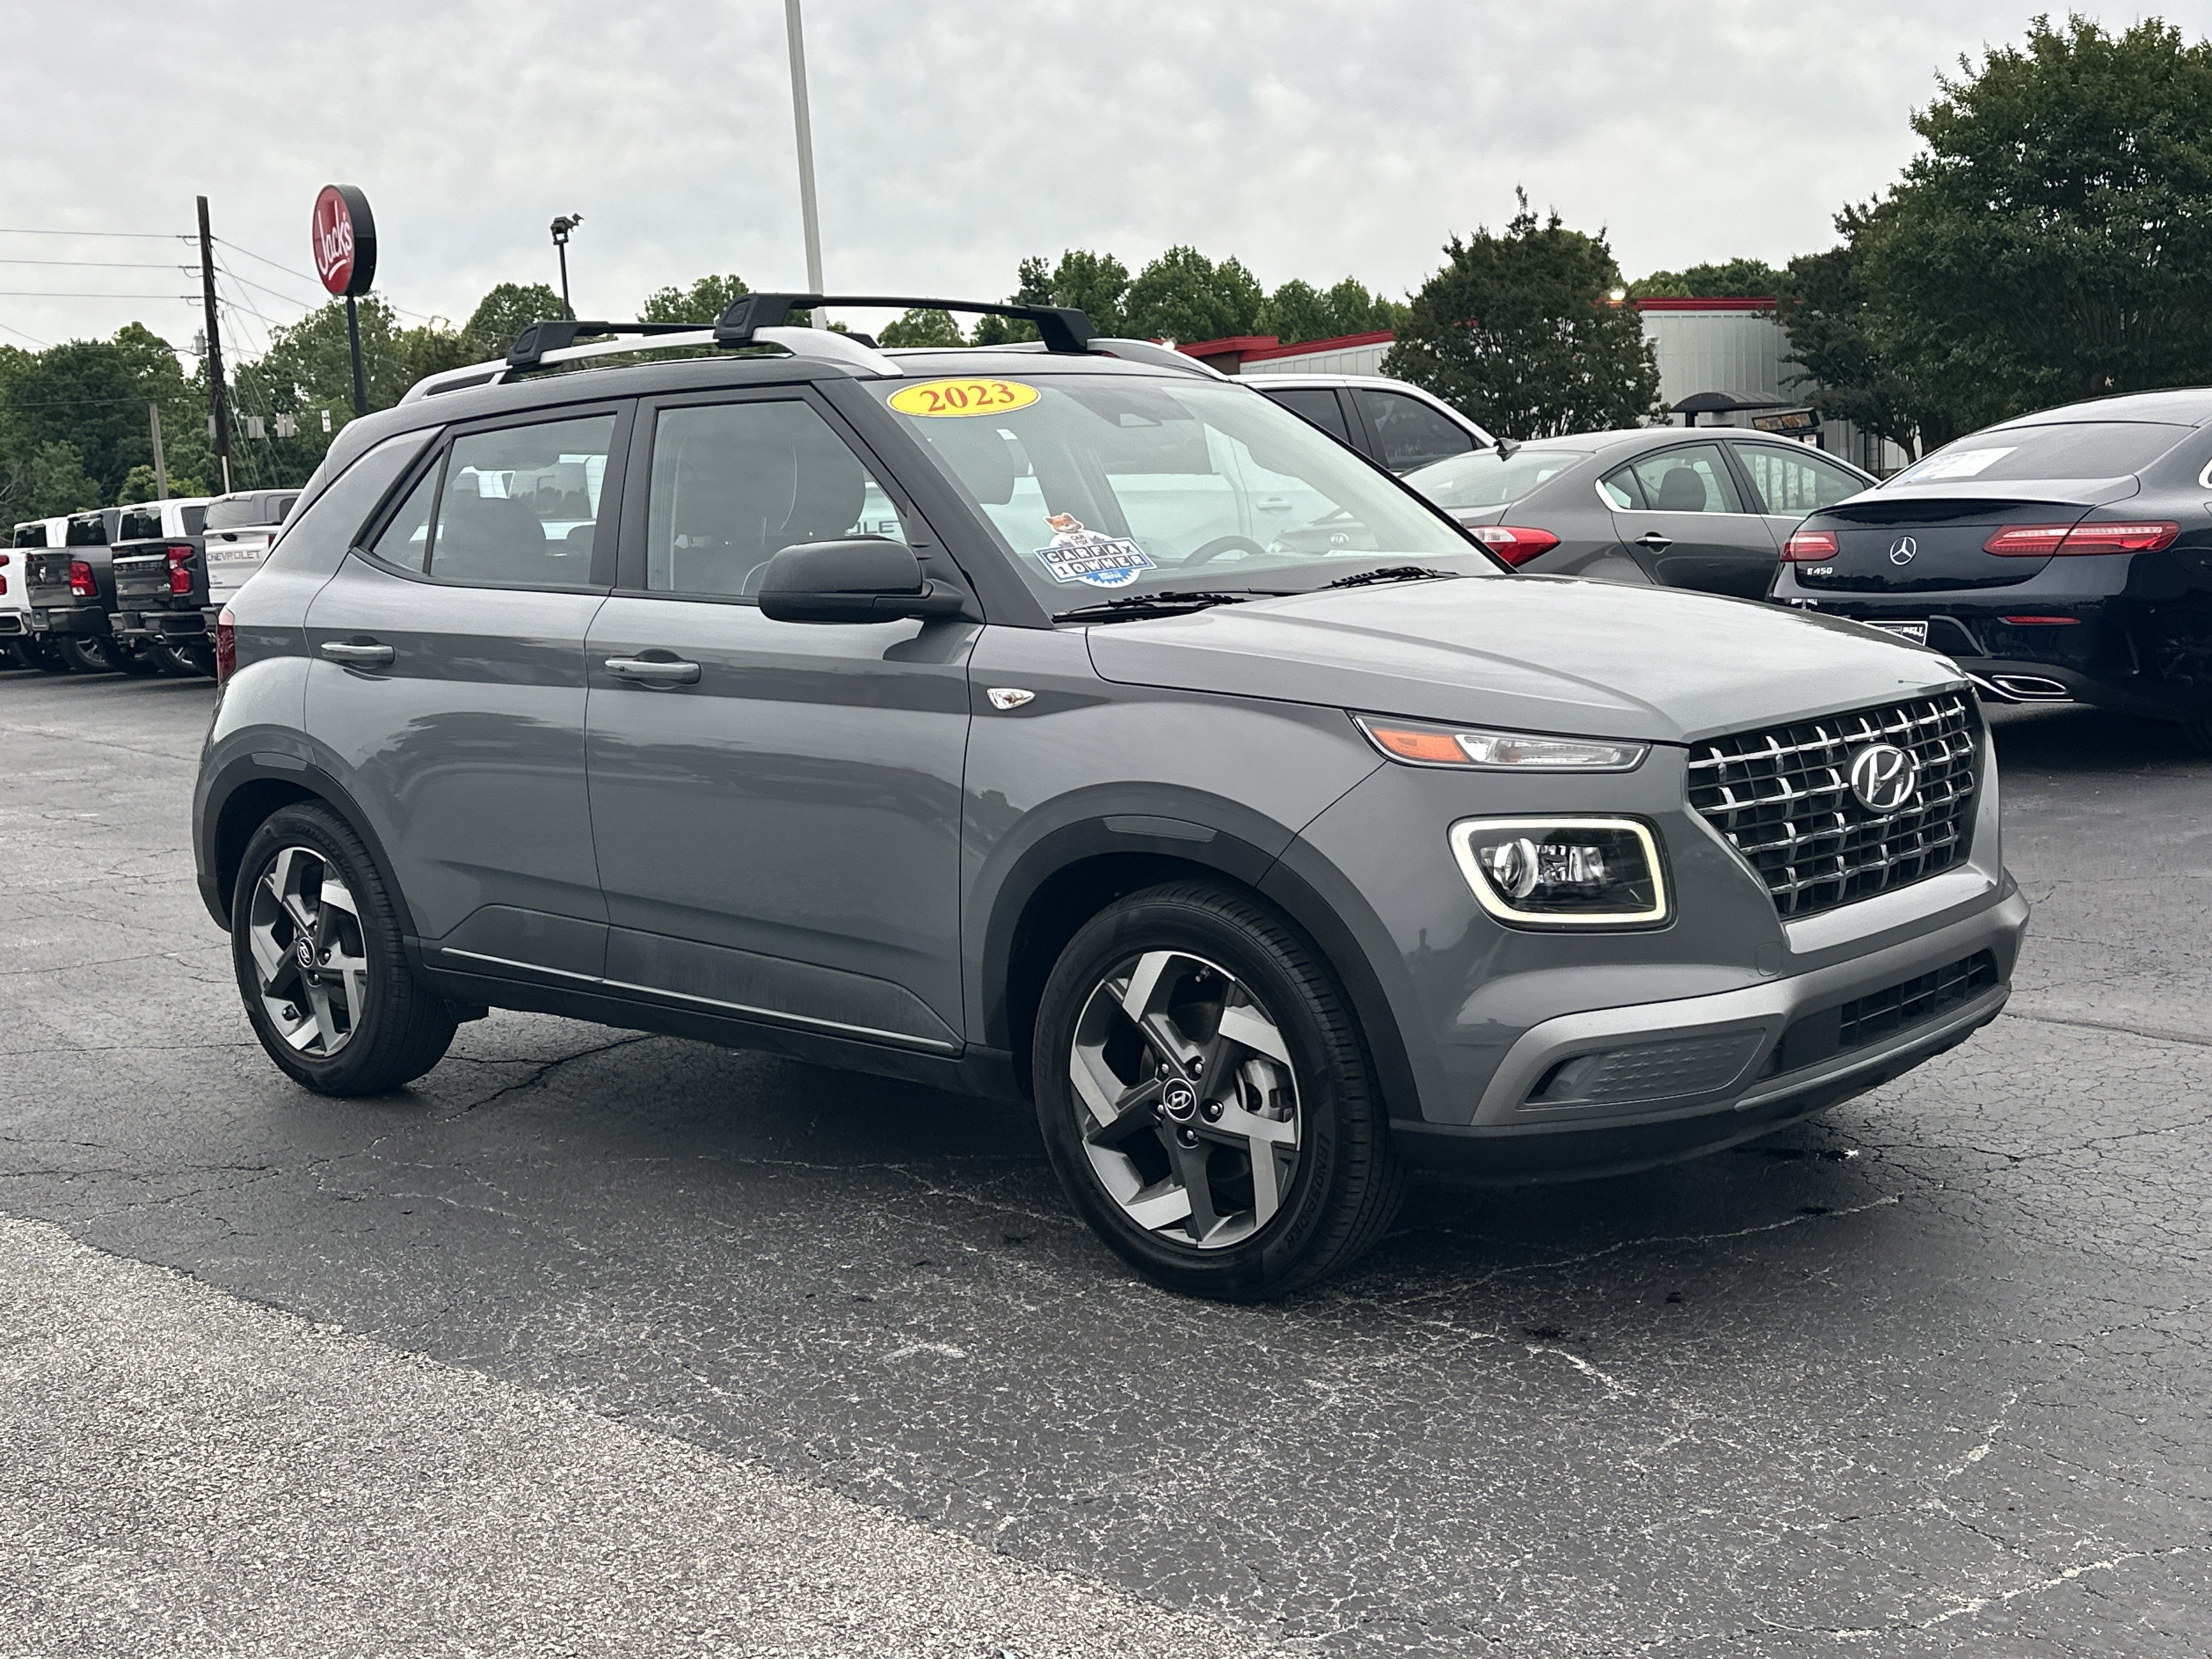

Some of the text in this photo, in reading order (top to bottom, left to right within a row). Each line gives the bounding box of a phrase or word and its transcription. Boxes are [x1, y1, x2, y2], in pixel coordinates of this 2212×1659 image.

[318, 200, 352, 275] Jack's
[919, 383, 1015, 412] 2023
[207, 550, 261, 562] CHEVROLET
[1045, 544, 1135, 563] CARFAX
[1058, 555, 1146, 575] 1 OWNER
[1813, 567, 1833, 575] 450
